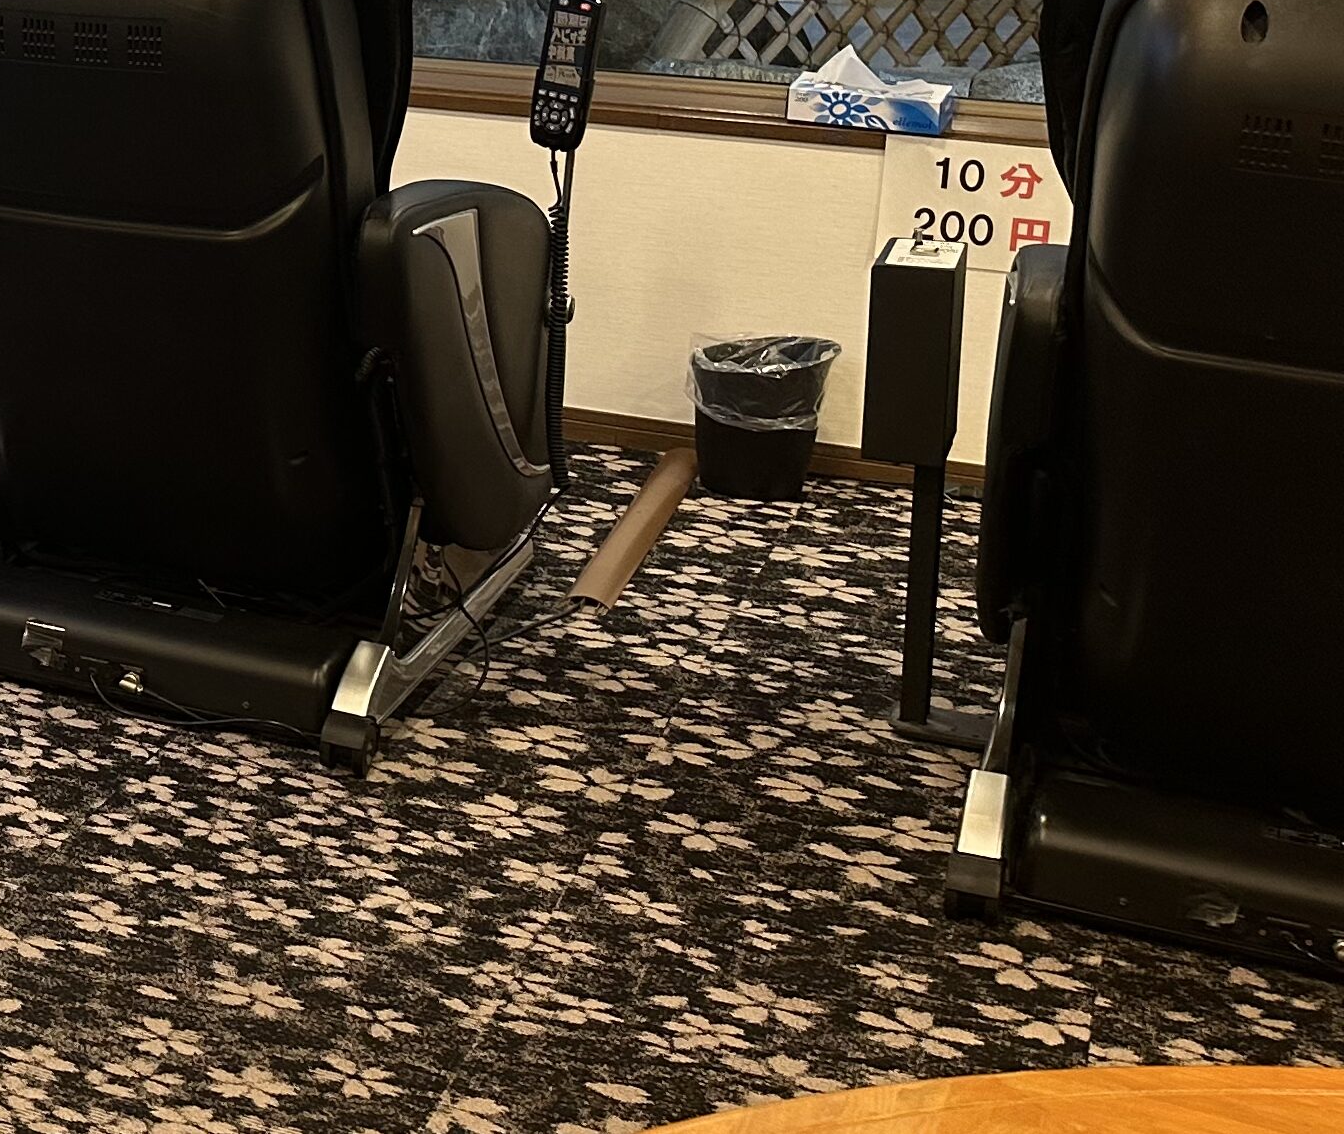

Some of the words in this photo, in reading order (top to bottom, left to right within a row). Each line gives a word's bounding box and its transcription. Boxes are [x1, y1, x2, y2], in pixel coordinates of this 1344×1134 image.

[936, 157, 985, 192] 10
[1000, 163, 1043, 199] 分
[913, 208, 994, 246] 200
[1009, 218, 1051, 252] 円
